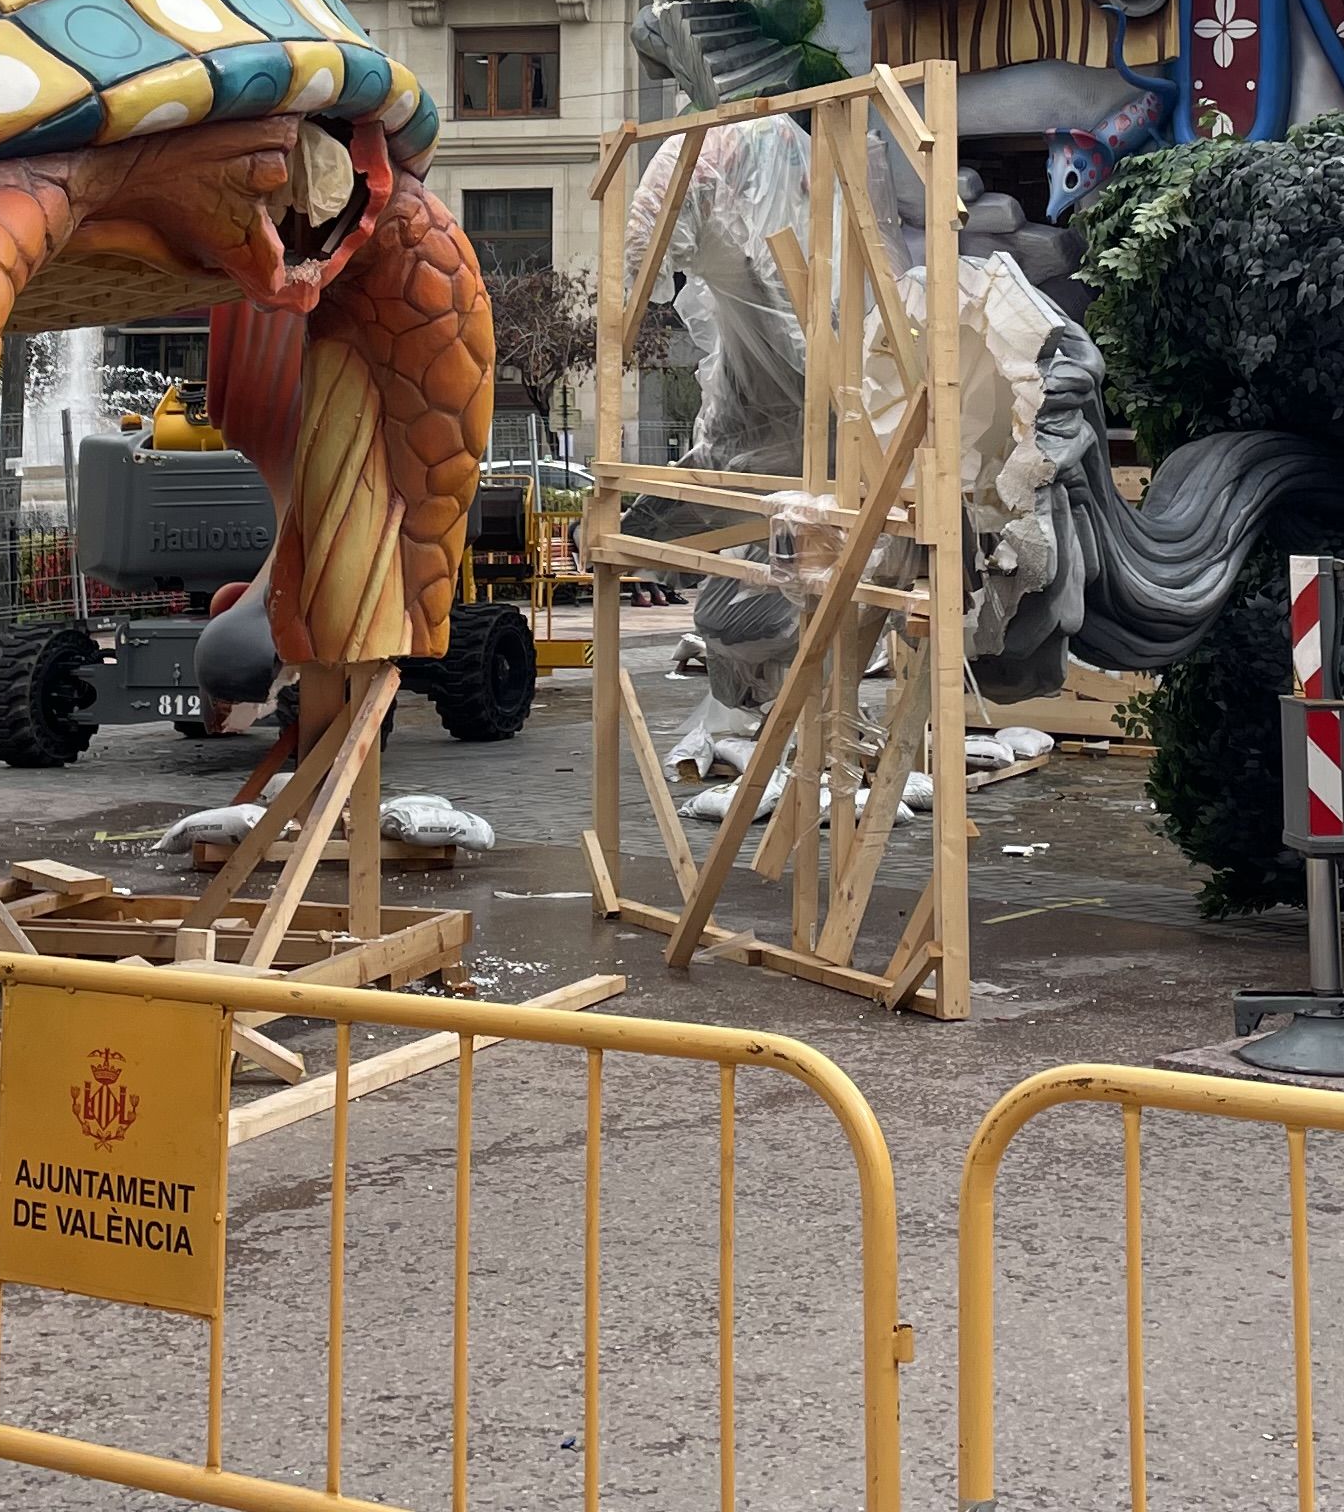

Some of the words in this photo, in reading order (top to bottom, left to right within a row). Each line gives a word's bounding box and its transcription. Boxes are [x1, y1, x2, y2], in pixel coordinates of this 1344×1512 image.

[149, 521, 270, 553] Haulotte
[15, 1159, 195, 1214] AJUNTAMENT
[13, 1198, 47, 1231] DE
[56, 1205, 194, 1256] VALÈNCIA
